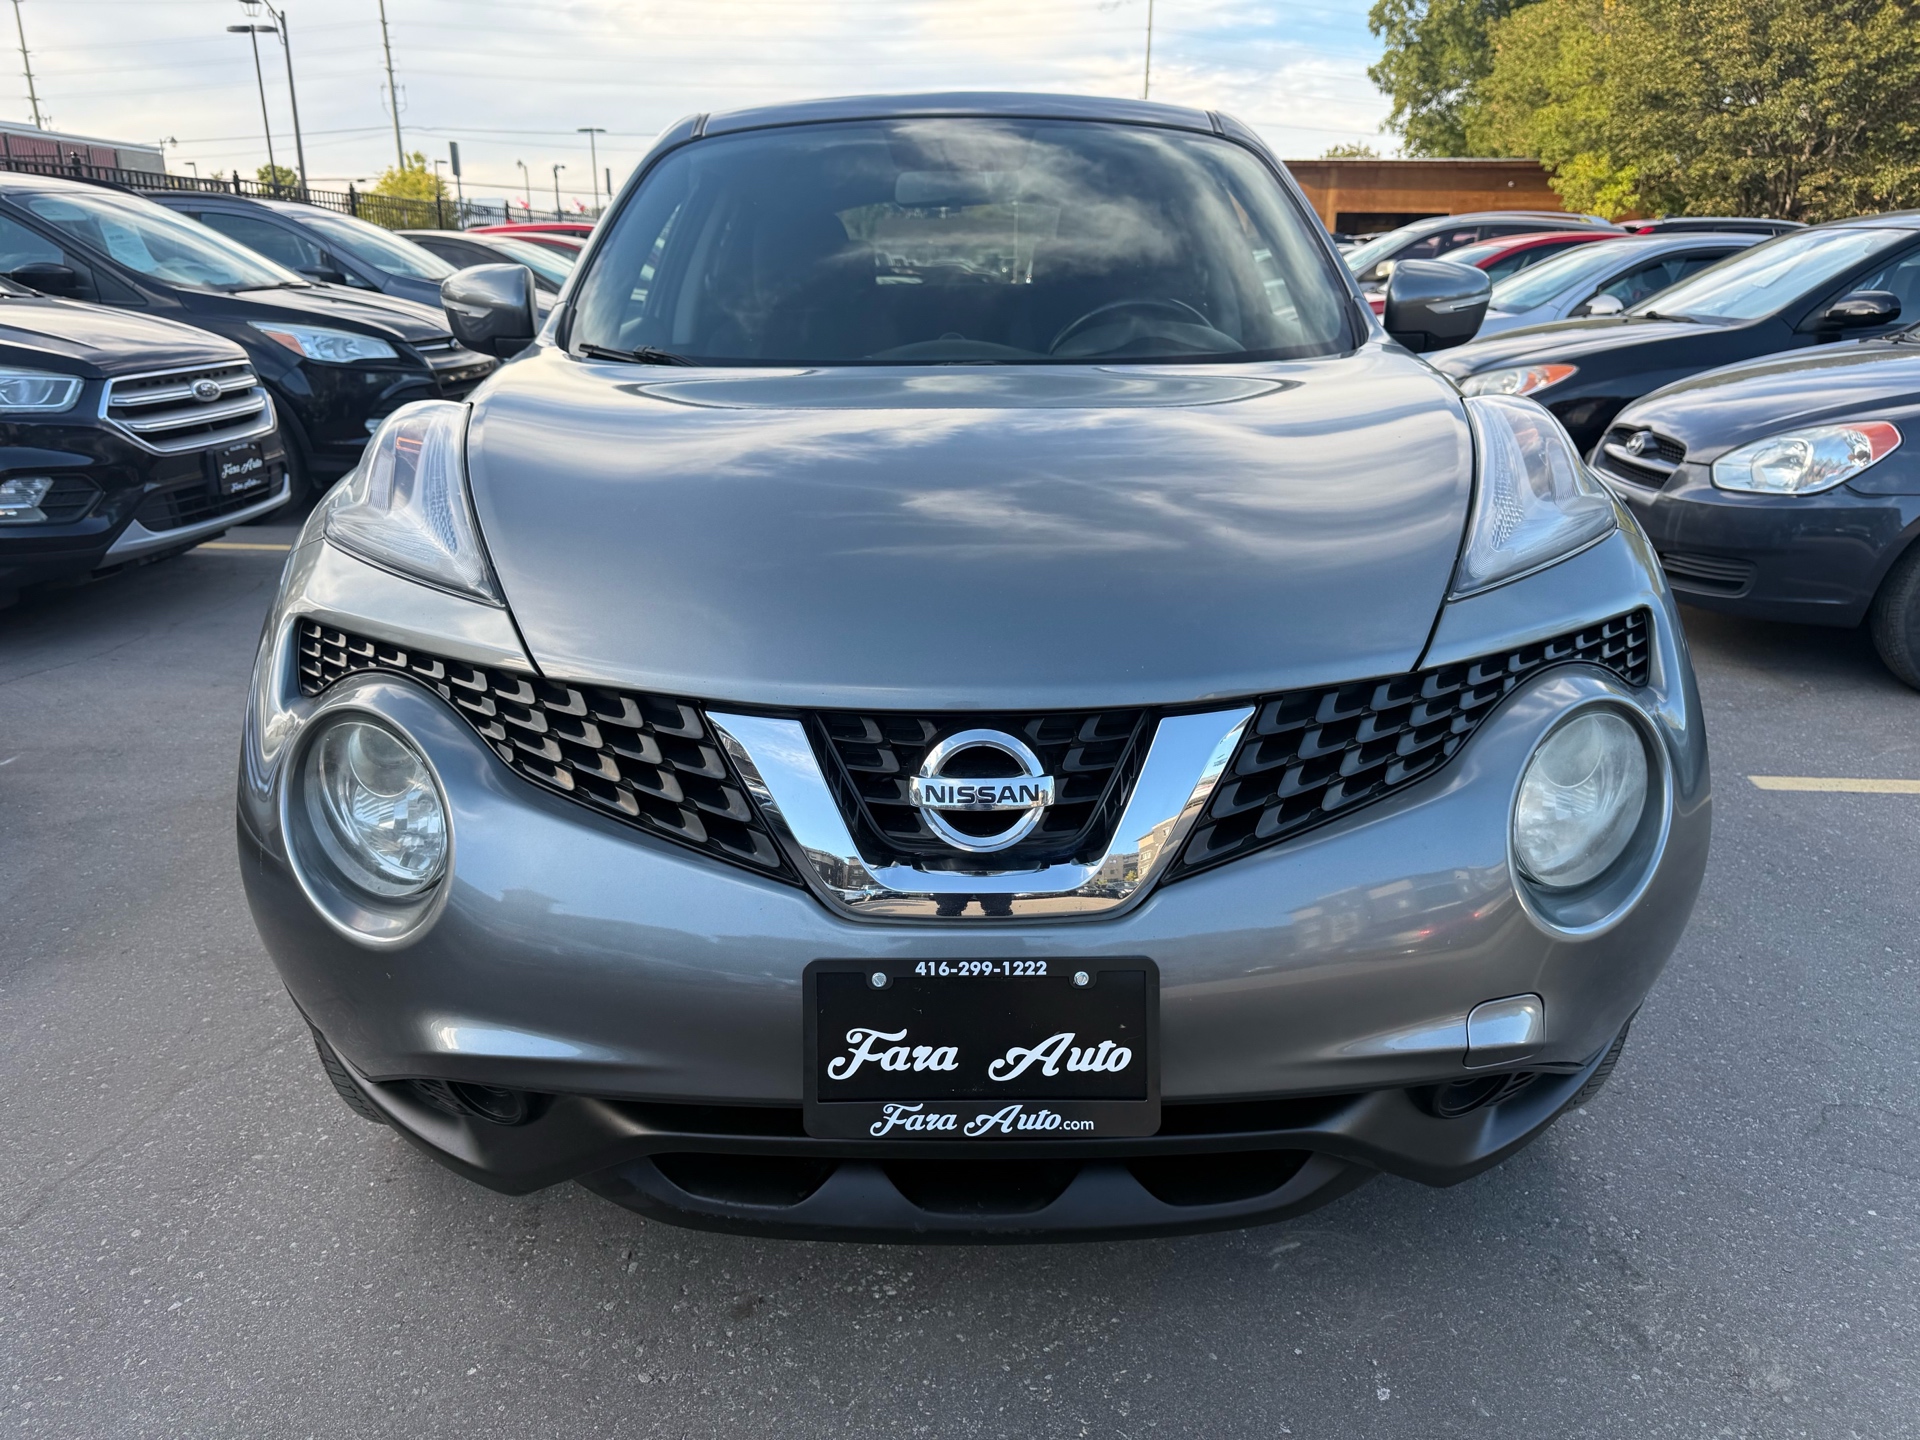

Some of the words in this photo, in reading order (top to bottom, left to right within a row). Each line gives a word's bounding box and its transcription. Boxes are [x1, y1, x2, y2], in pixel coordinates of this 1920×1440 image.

[925, 784, 1040, 804] NISSAN
[915, 960, 1047, 977] 416-299-1222
[827, 1027, 959, 1081] Fara
[988, 1032, 1133, 1082] Auto
[869, 1103, 958, 1137] Fara
[963, 1104, 1095, 1137] Auto.com
